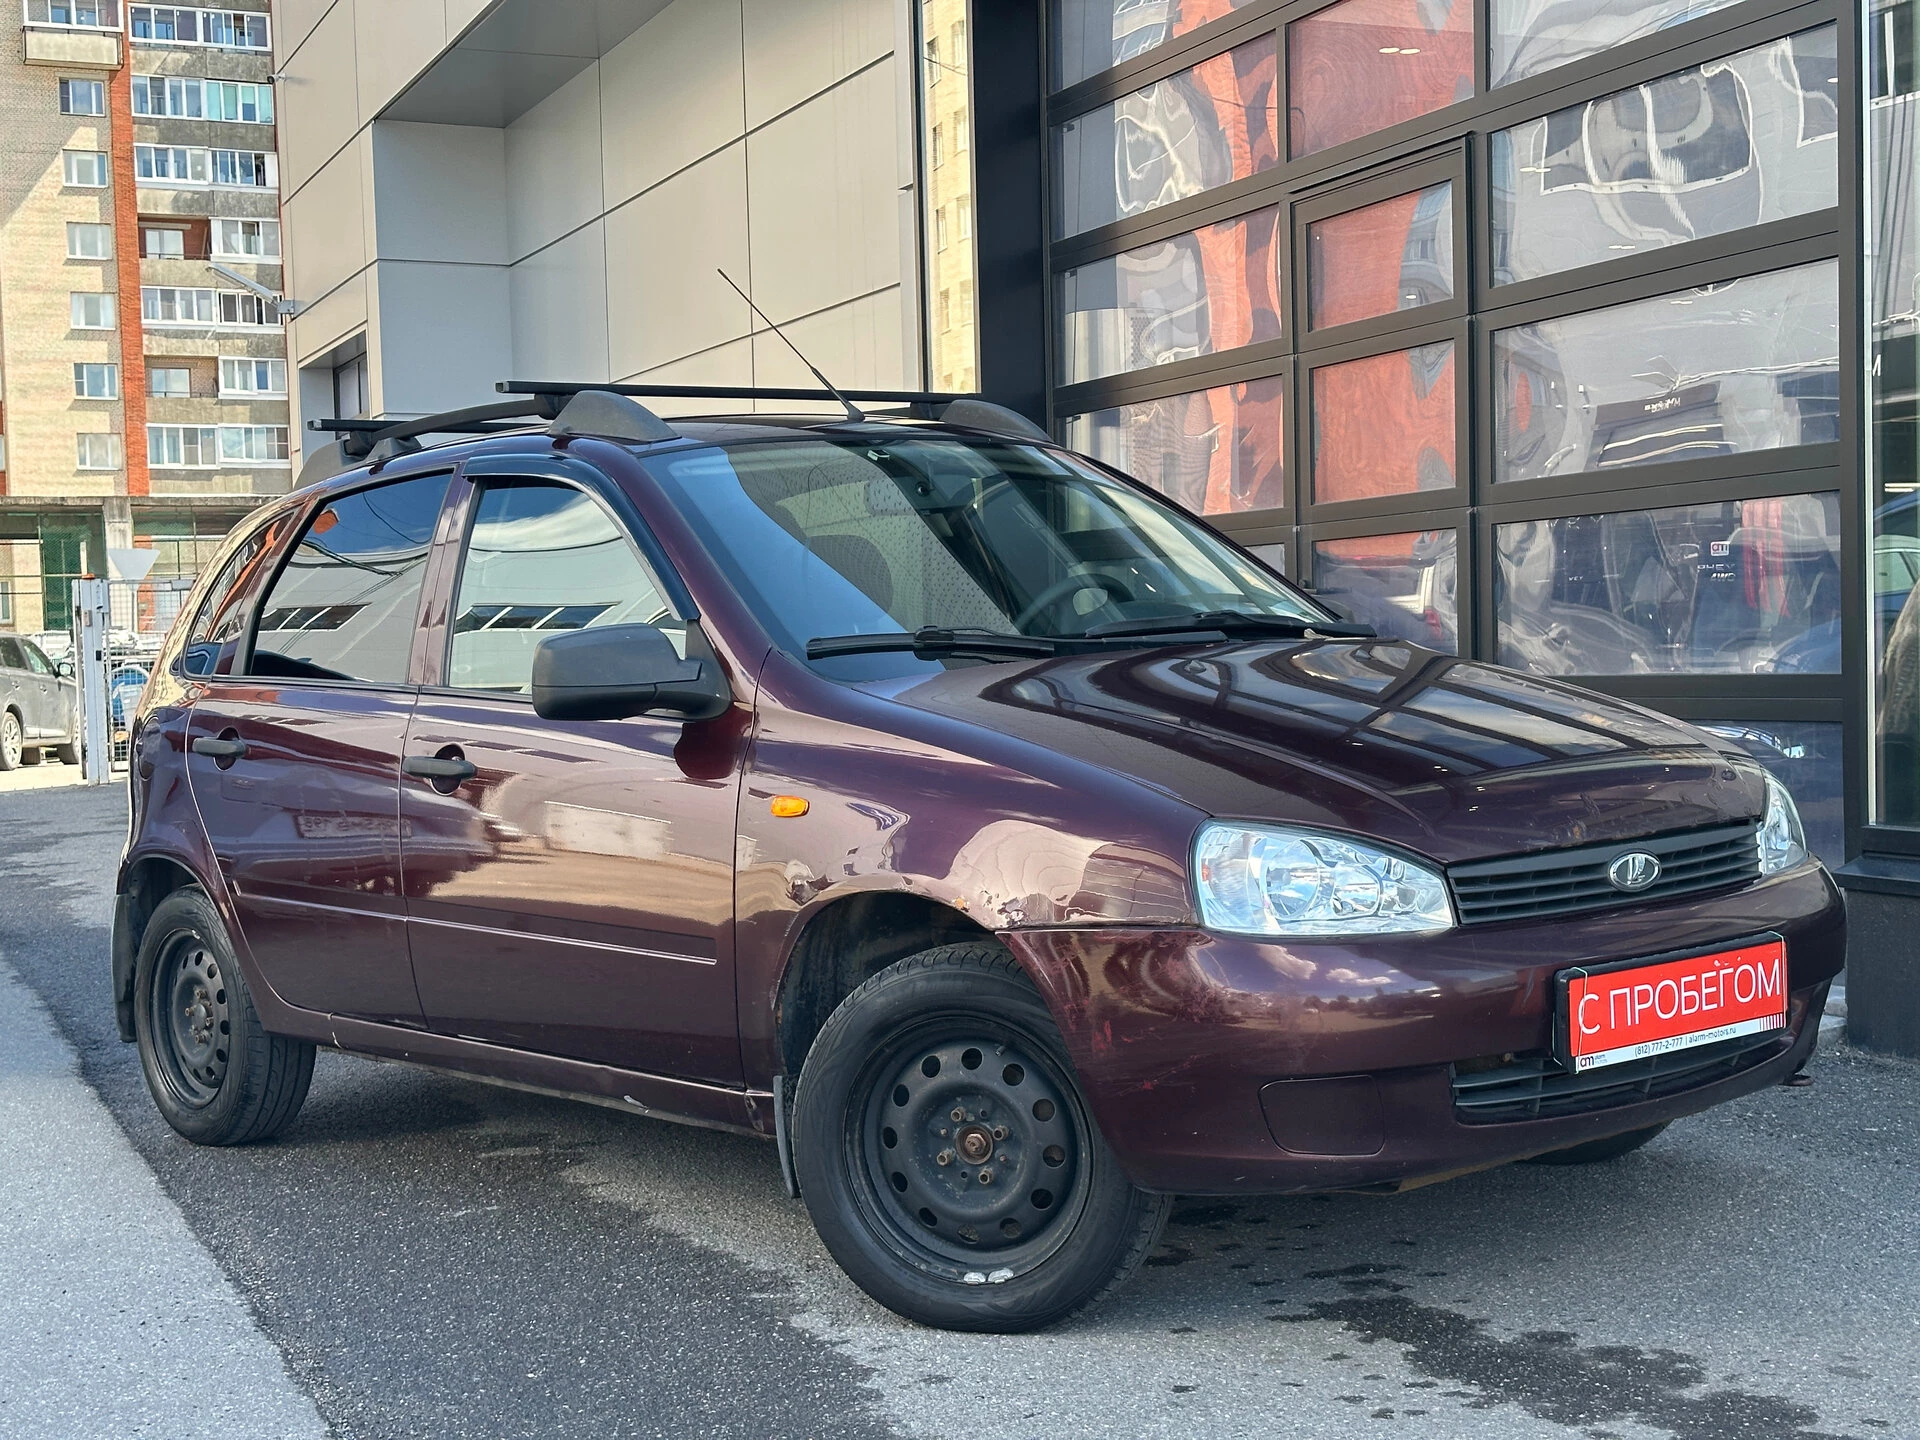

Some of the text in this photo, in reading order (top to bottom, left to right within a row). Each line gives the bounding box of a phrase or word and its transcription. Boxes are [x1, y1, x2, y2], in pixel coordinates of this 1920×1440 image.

[1578, 958, 1780, 1034] С ПРОБЕГОМ
[1634, 1026, 1736, 1057] (812) 777-2-777 alarm-motors.ru
